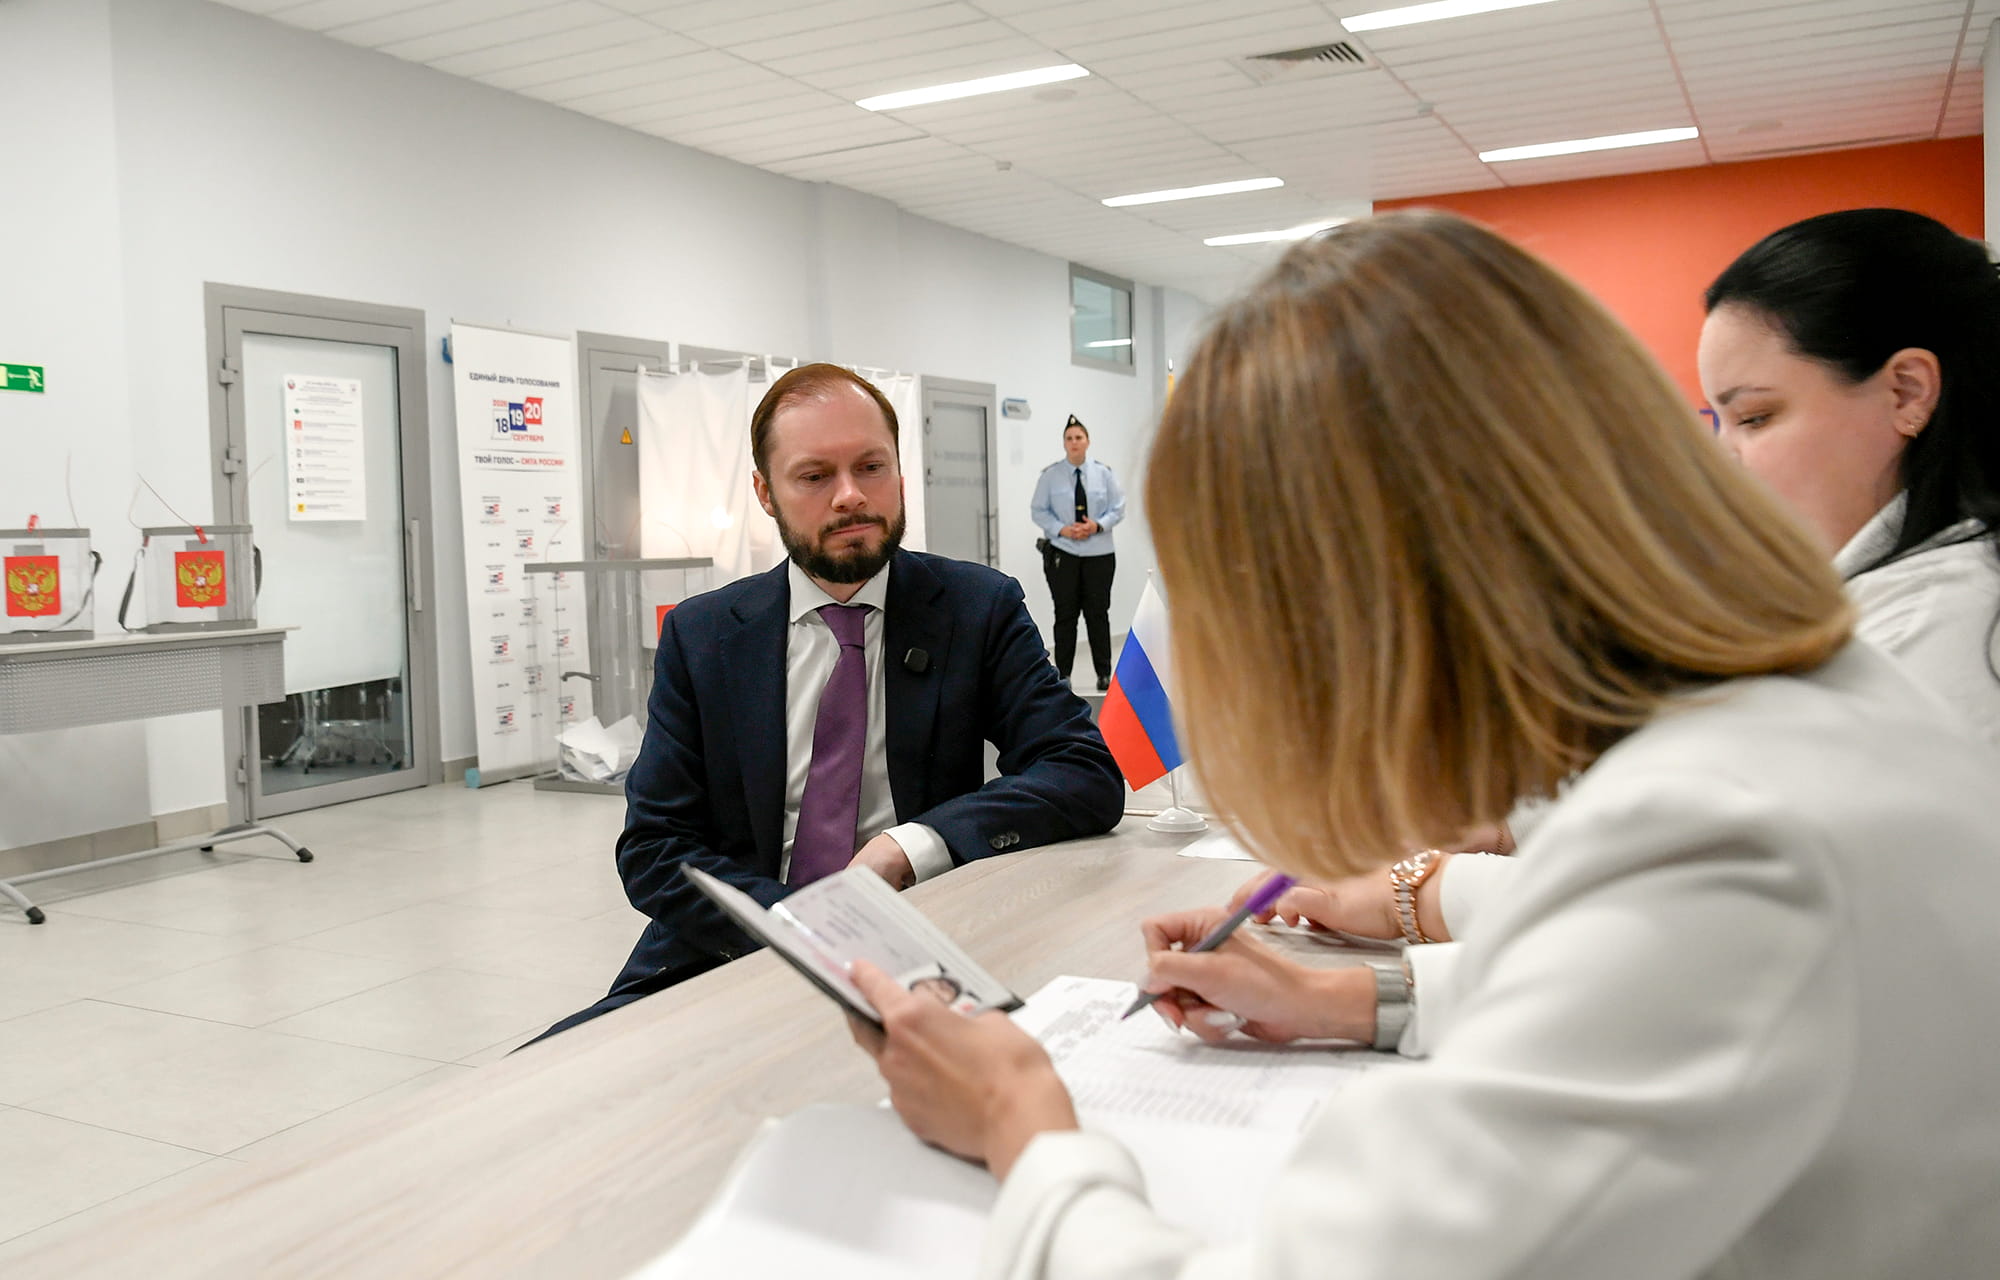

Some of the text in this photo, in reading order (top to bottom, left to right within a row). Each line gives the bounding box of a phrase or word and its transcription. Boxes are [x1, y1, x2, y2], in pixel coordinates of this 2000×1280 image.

[469, 372, 560, 388] ЕДИНЫЙ ДЕНЬ ГОЛОСОВАНИЯ
[495, 402, 541, 433] 18 19 20
[512, 433, 544, 442] СЕНТЯБРЯ
[474, 454, 492, 464] ТВОЙ
[493, 456, 514, 465] ГОЛОС
[521, 457, 538, 465] СИЛА
